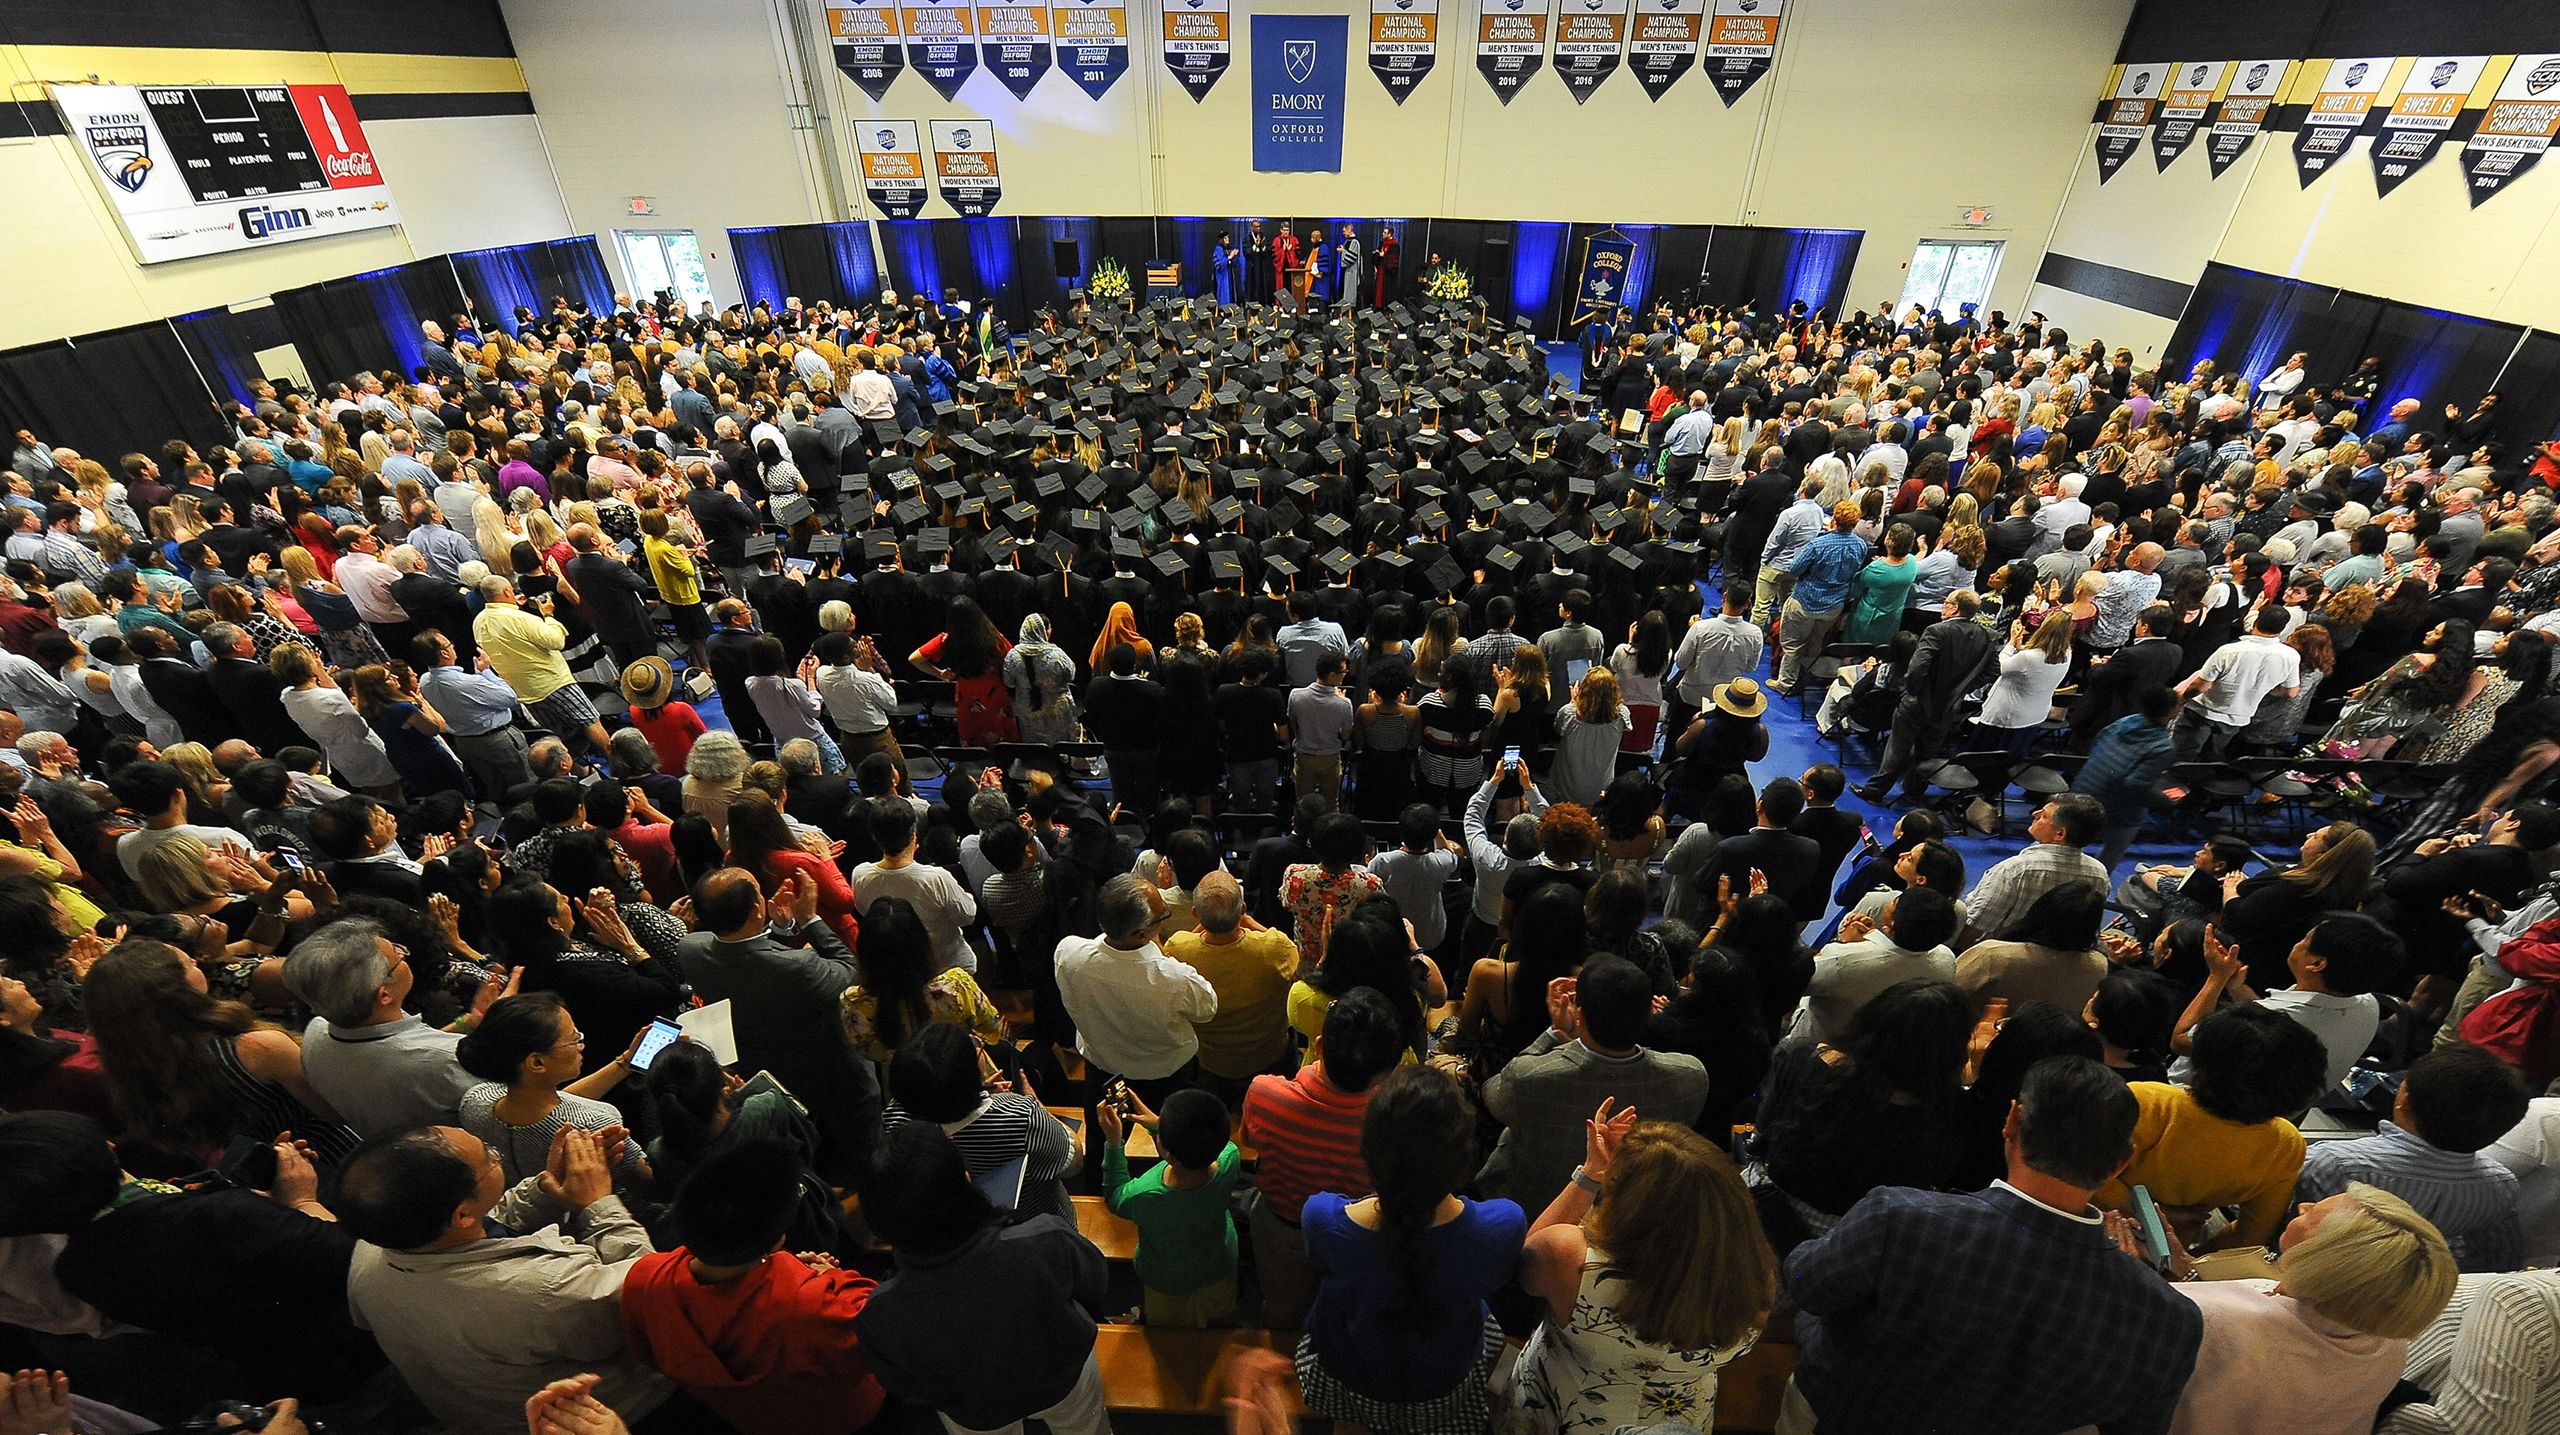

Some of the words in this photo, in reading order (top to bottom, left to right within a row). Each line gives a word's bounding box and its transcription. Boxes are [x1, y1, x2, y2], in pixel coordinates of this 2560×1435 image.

[841, 10, 883, 22] NATIONAL
[916, 9, 957, 21] NATIONAL
[991, 9, 1033, 21] NATIONAL
[1068, 10, 1111, 22] NATIONAL
[1176, 14, 1215, 26] NATIONAL
[988, 21, 1039, 33] CHAMPIONS
[1384, 16, 1423, 27] NATIONAL
[1494, 17, 1533, 28] NATIONAL
[1572, 17, 1611, 28] NATIONAL
[1648, 16, 1687, 27] NATIONAL
[1725, 19, 1764, 30] NATIONAL
[840, 22, 888, 34] CHAMPIONS
[914, 22, 964, 34] CHAMPIONS
[1064, 23, 1116, 35] CHAMPIONS
[1174, 25, 1219, 37] CHAMPIONS
[1380, 27, 1427, 39] CHAMPIONS
[1567, 28, 1614, 39] CHAMPIONS
[1642, 27, 1689, 38] CHAMPIONS
[1489, 28, 1536, 40] CHAMPIONS
[1720, 30, 1767, 41] CHAMPIONS
[1174, 42, 1194, 50] MEN'S
[1195, 42, 1219, 50] TENNIS
[1375, 44, 1405, 52] WOMEN'S
[1406, 44, 1430, 52] TENNIS
[1640, 43, 1660, 51] MEN'S
[1662, 43, 1687, 51] TENNIS
[1712, 46, 1743, 54] WOMEN'S
[1744, 47, 1767, 55] TENNIS
[862, 68, 883, 78] 2006
[935, 68, 955, 78] 2007
[1008, 68, 1029, 77] 2009
[1084, 71, 1104, 81] 2011
[1188, 75, 1207, 84] 2015
[1392, 76, 1410, 85] 2015
[1649, 74, 1667, 83] 2017
[1724, 80, 1742, 88] 2017
[146, 91, 185, 105] GUEST
[256, 90, 286, 102] HOME
[2171, 93, 2190, 106] FINAL
[2190, 94, 2210, 106] FOUR
[1272, 94, 1325, 110] EMORY
[2223, 99, 2271, 110] CHAMPIONSHIP
[2320, 96, 2351, 110] SWEET
[2353, 96, 2367, 110] 16
[2402, 97, 2437, 113] SWEET
[2437, 98, 2455, 114] 16
[2226, 109, 2256, 120] FINALIST
[2493, 104, 2560, 121] CONFERENCE
[89, 114, 140, 125] EMORY
[2328, 115, 2361, 123] BASKETBALL
[2391, 116, 2410, 125] MEN'S
[2411, 118, 2450, 127] BASKETBALL
[1272, 125, 1324, 133] OXFORD
[2488, 118, 2550, 133] CHAMPIONS
[92, 128, 144, 141] OXFORD
[212, 132, 244, 144] PERIOD
[2395, 133, 2433, 142] EMORY
[2387, 143, 2425, 152] OXFORD
[2471, 137, 2495, 147] MEN'S
[2496, 138, 2548, 149] BASKETBALL
[873, 156, 909, 165] NATIONAL
[948, 155, 983, 164] NATIONAL
[2104, 158, 2118, 166] 2017
[872, 165, 914, 175] CHAMPIONS
[946, 164, 989, 174] CHAMPIONS
[244, 187, 268, 196] MATCH
[315, 209, 334, 218] Jeep
[238, 205, 312, 240] Ginn
[1596, 252, 1623, 263] OXFORD
[1593, 260, 1623, 272] COLLEGE
